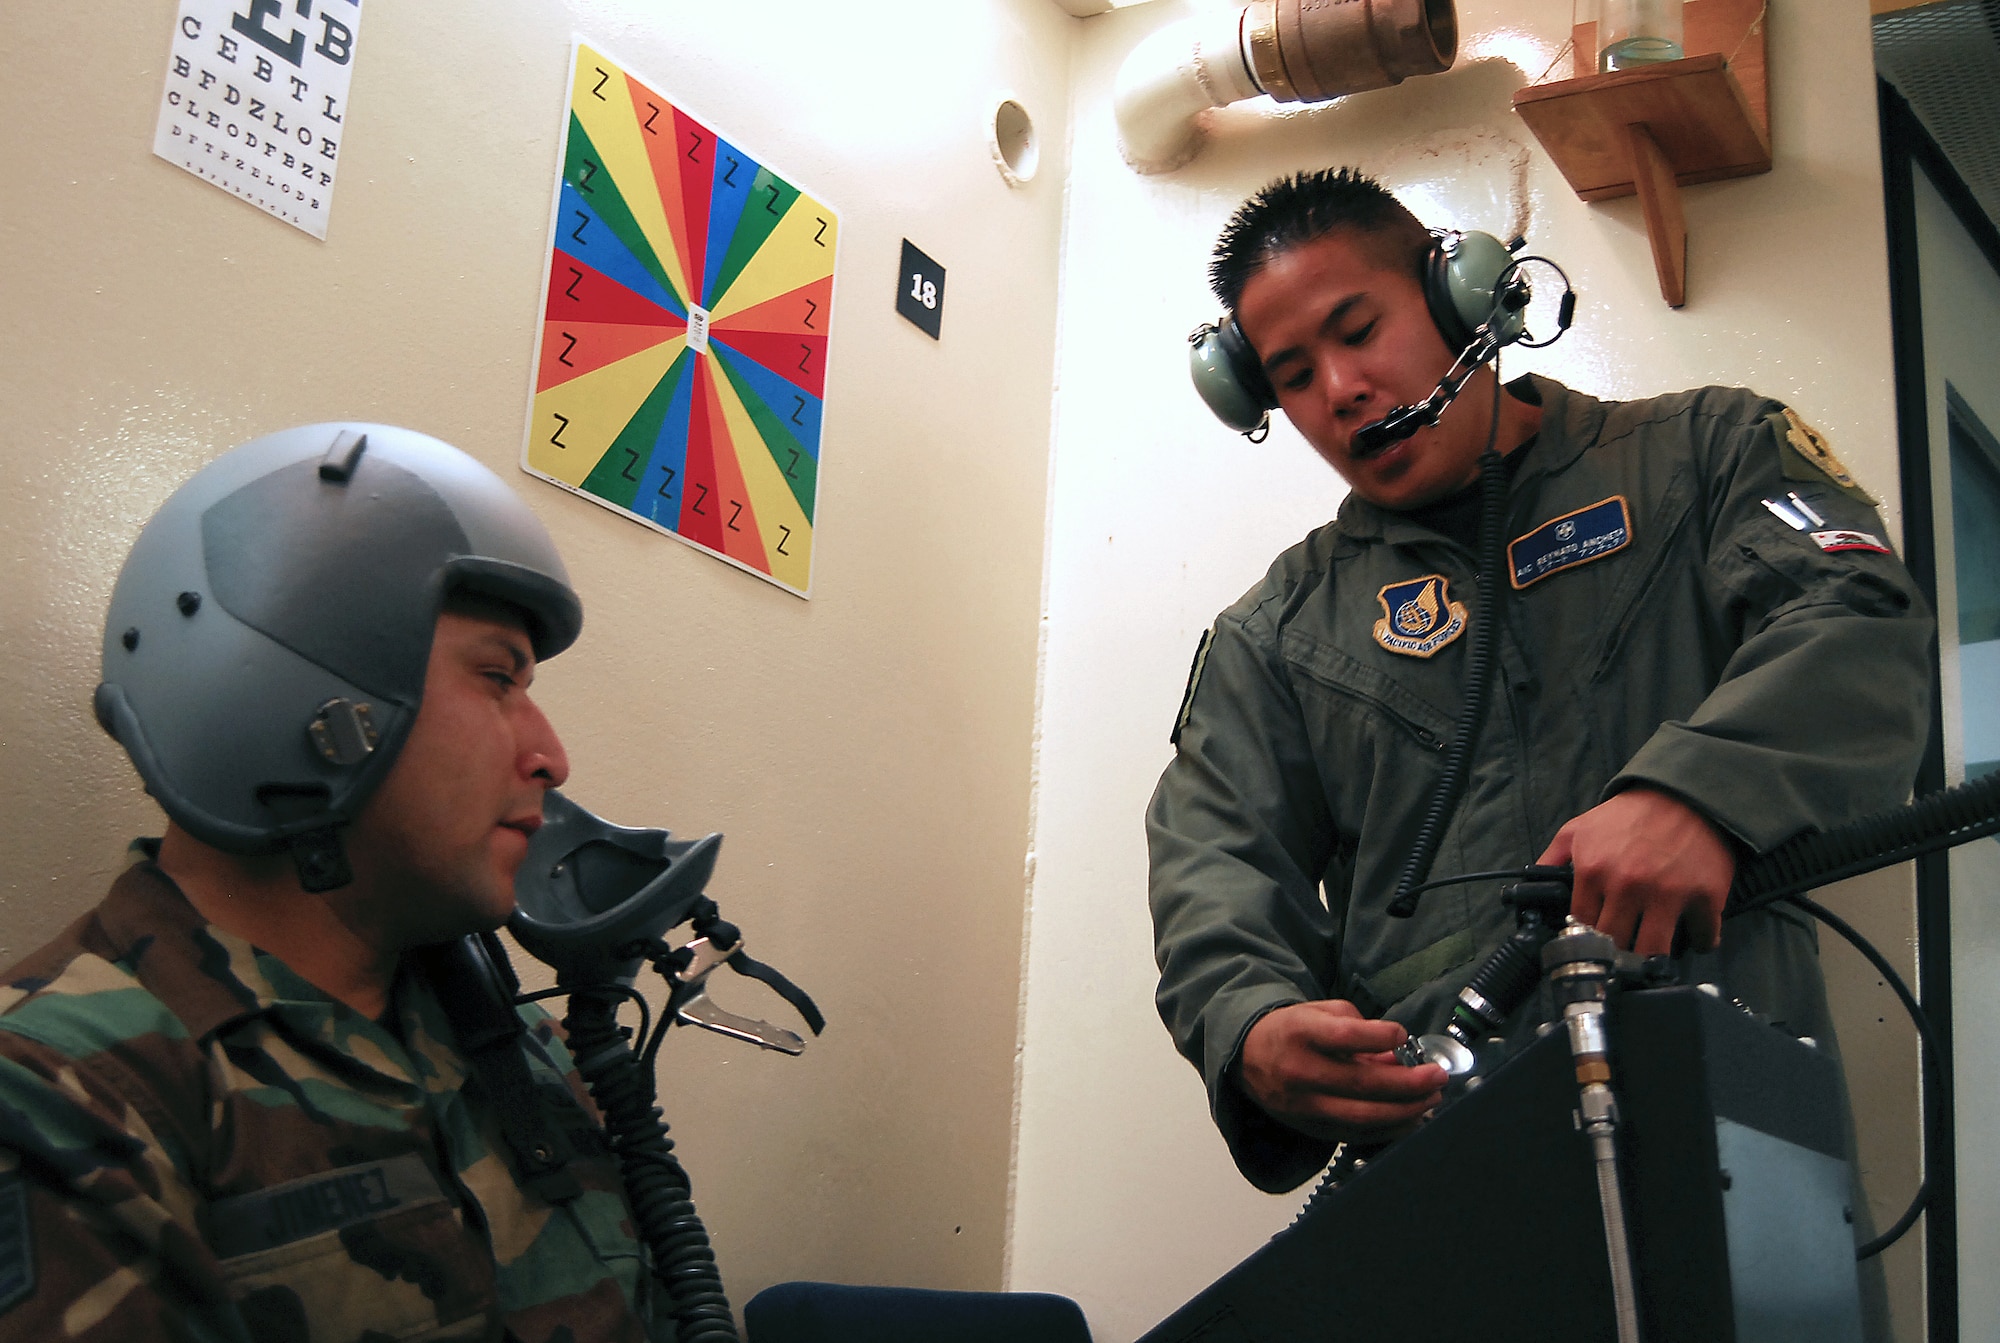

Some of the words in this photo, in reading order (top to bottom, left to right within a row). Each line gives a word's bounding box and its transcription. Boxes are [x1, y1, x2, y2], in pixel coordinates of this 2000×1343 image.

[314, 11, 353, 66] B
[181, 16, 202, 40] C
[216, 34, 238, 64] E
[253, 55, 273, 83] B
[290, 75, 308, 103] T
[322, 95, 341, 124] L
[592, 67, 609, 101] Z
[172, 55, 191, 78] B
[198, 69, 216, 90] F
[223, 84, 241, 106] D
[248, 98, 266, 121] Z
[273, 111, 288, 135] L
[297, 126, 312, 146] O
[319, 137, 337, 160] E
[645, 102, 660, 135] Z
[687, 132, 702, 163] Z
[579, 158, 598, 193] Z
[724, 156, 739, 188] Z
[766, 184, 780, 216] Z
[572, 210, 590, 246] Z
[814, 217, 827, 247] Z
[565, 267, 583, 301] Z
[910, 273, 937, 310] 18
[804, 299, 817, 329] Z
[559, 332, 577, 367] Z
[799, 344, 812, 374] Z
[791, 395, 806, 426] Z
[550, 413, 569, 449] Z
[621, 447, 640, 482] Z
[785, 448, 800, 479] Z
[658, 465, 676, 499] Z
[692, 483, 708, 515] Z
[728, 500, 742, 532] Z
[776, 524, 791, 556] Z
[1383, 634, 1417, 650] PACIFIC
